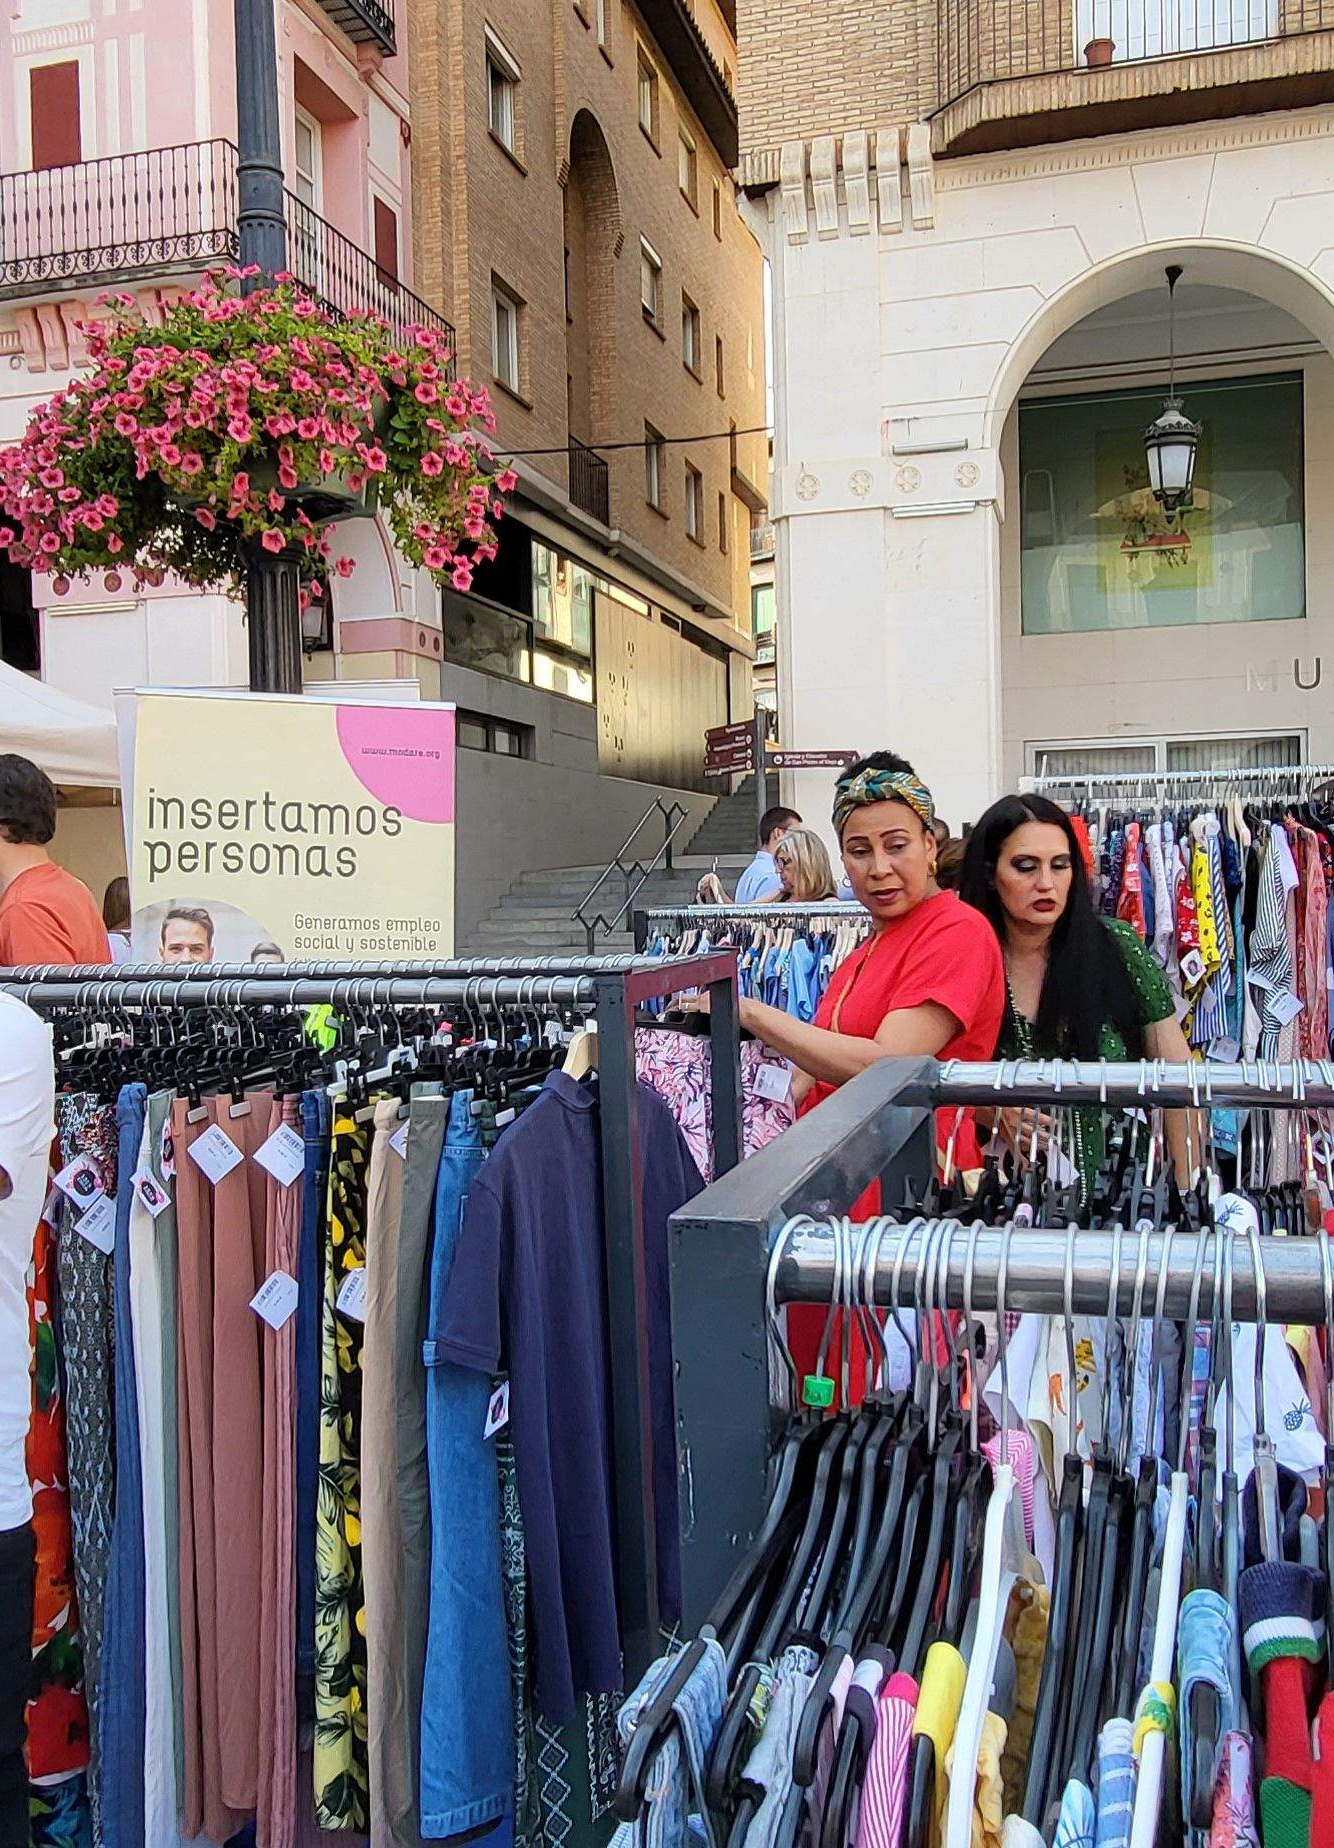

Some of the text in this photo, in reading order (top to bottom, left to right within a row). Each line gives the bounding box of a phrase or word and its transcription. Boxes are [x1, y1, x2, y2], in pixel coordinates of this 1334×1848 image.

[361, 747, 441, 760] www.modare.org
[148, 787, 402, 837] insertamos
[143, 839, 358, 883] personas
[294, 913, 441, 934] Generamos empleo
[294, 934, 437, 953] social y sostenible
